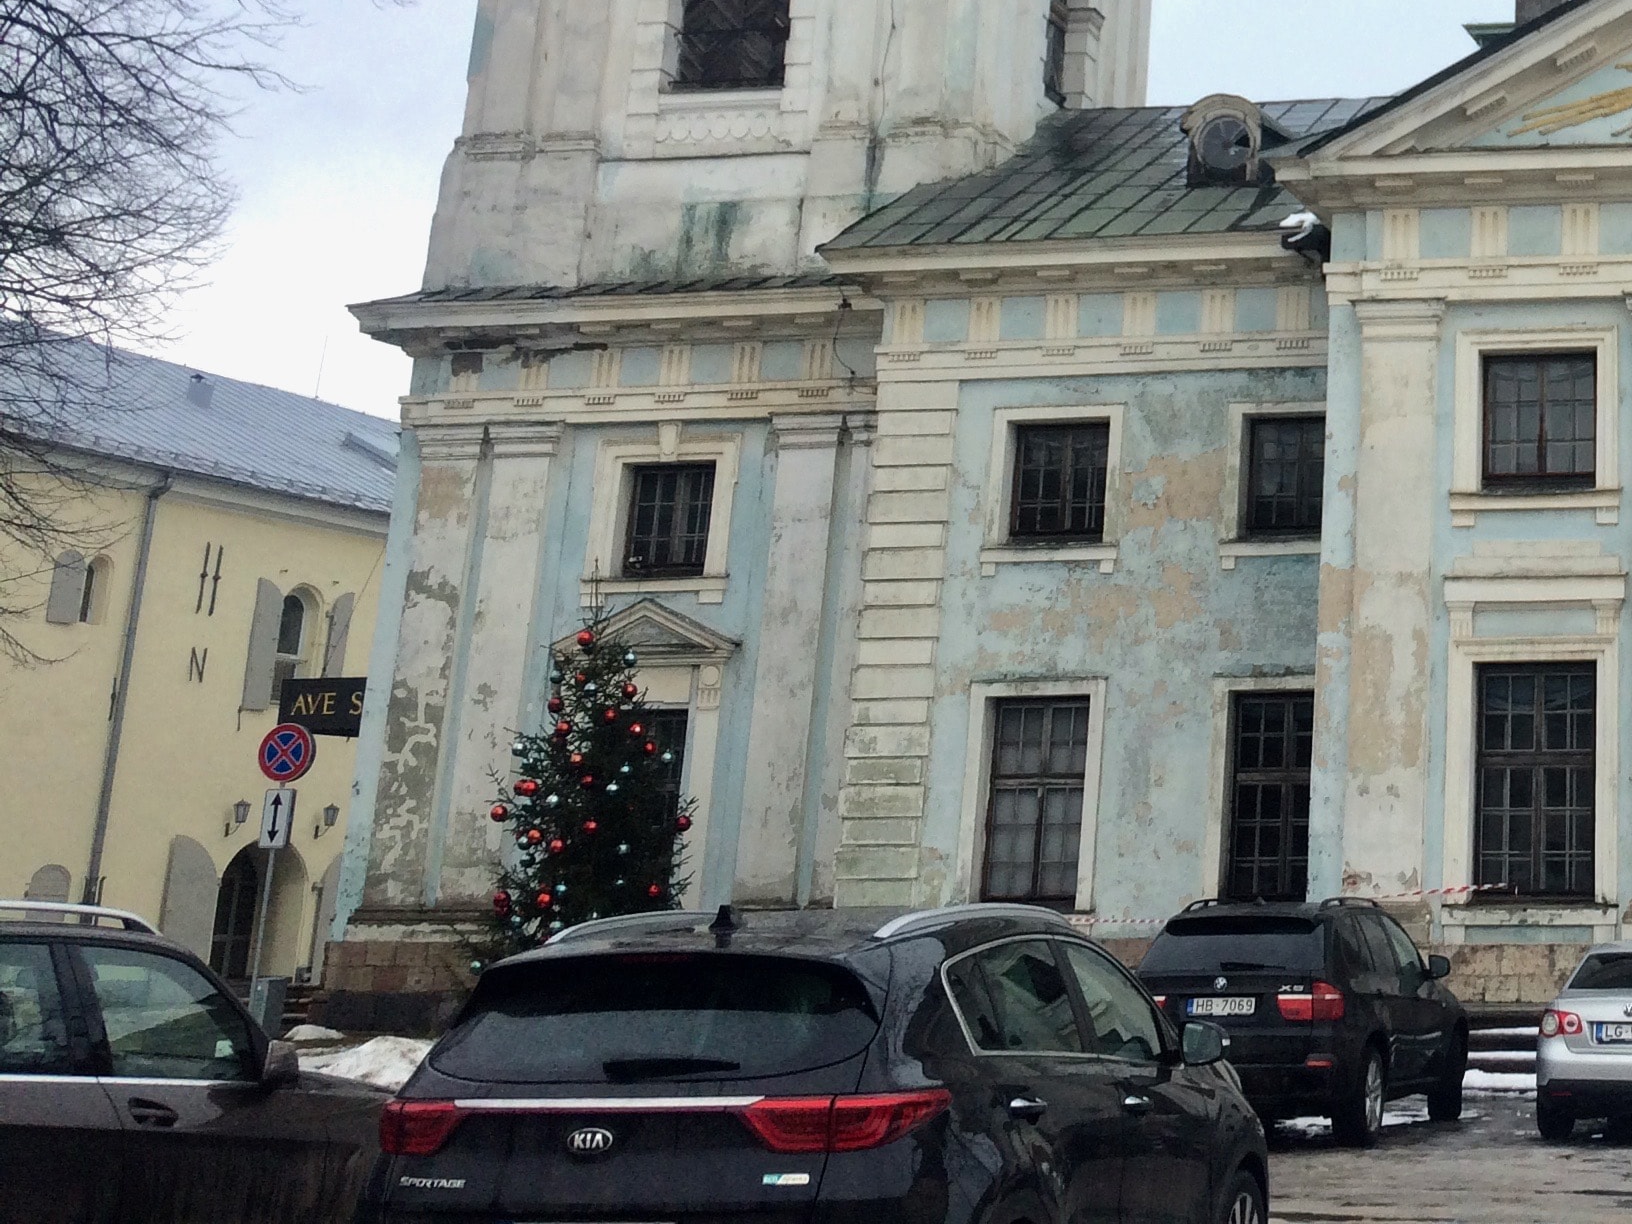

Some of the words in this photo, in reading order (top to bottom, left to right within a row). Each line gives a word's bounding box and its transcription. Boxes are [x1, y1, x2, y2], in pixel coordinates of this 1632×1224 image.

[290, 692, 337, 716] AVE
[573, 1132, 604, 1149] KIA
[400, 1176, 467, 1188] SPORTAGE
